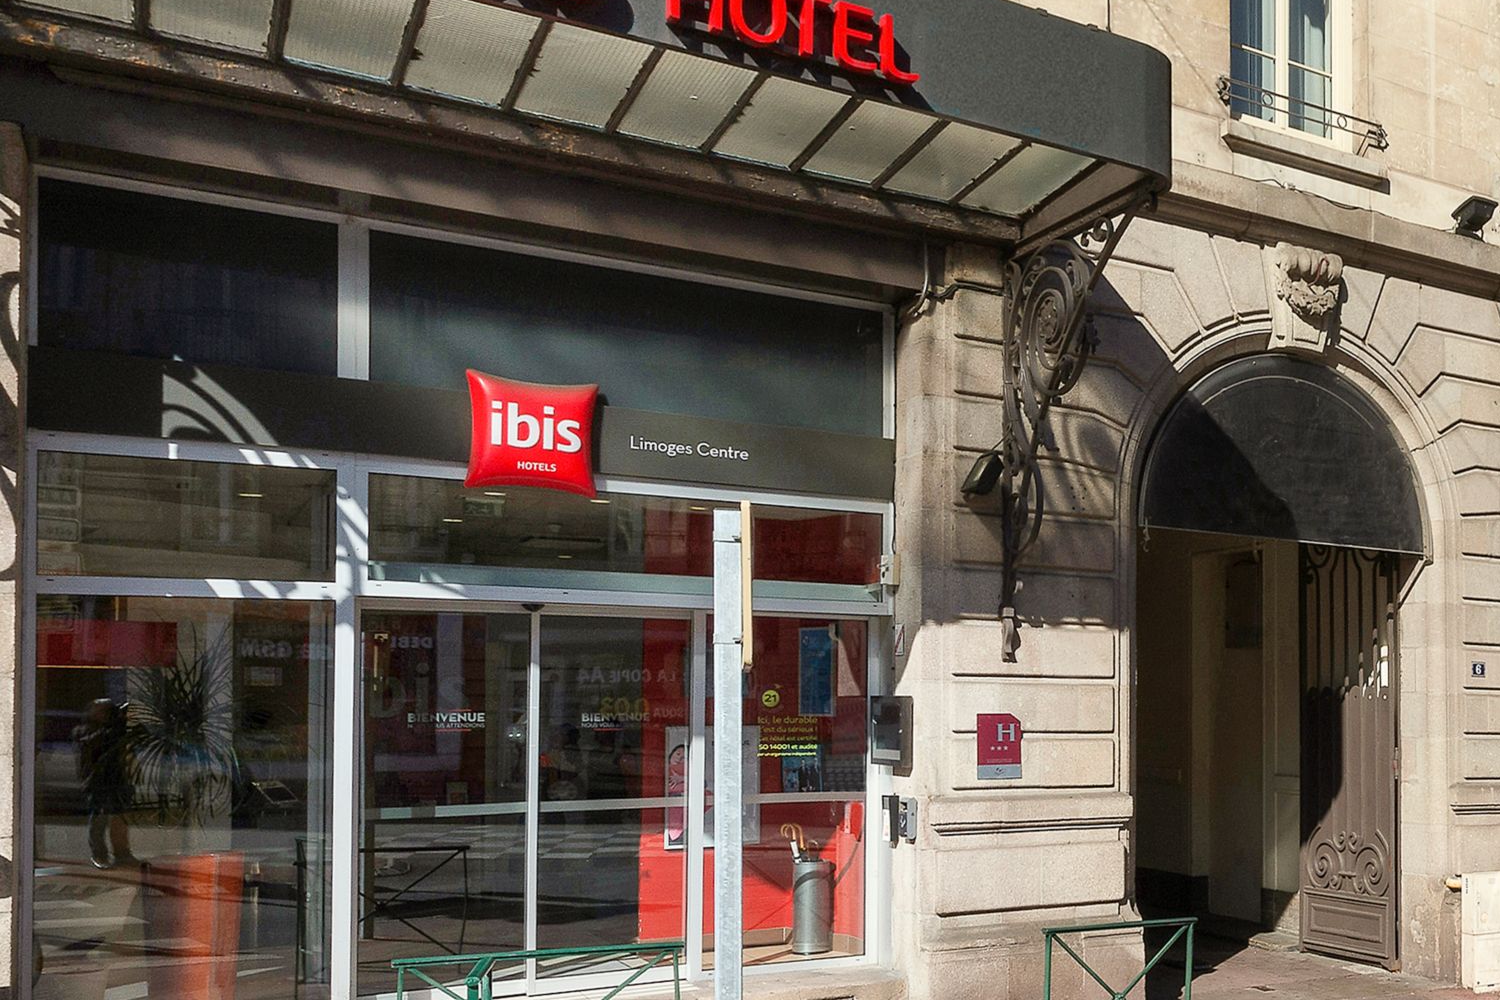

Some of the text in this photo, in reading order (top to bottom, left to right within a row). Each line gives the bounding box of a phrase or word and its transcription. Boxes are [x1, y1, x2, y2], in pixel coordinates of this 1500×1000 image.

[490, 400, 582, 453] ibis
[630, 435, 749, 460] Limoges Centre
[517, 460, 557, 473] HOTELS
[1475, 664, 1482, 675] 6
[764, 693, 777, 703] 21
[407, 712, 485, 723] BIENVENUE
[581, 712, 651, 722] BIENVENUE
[997, 723, 1016, 742] H
